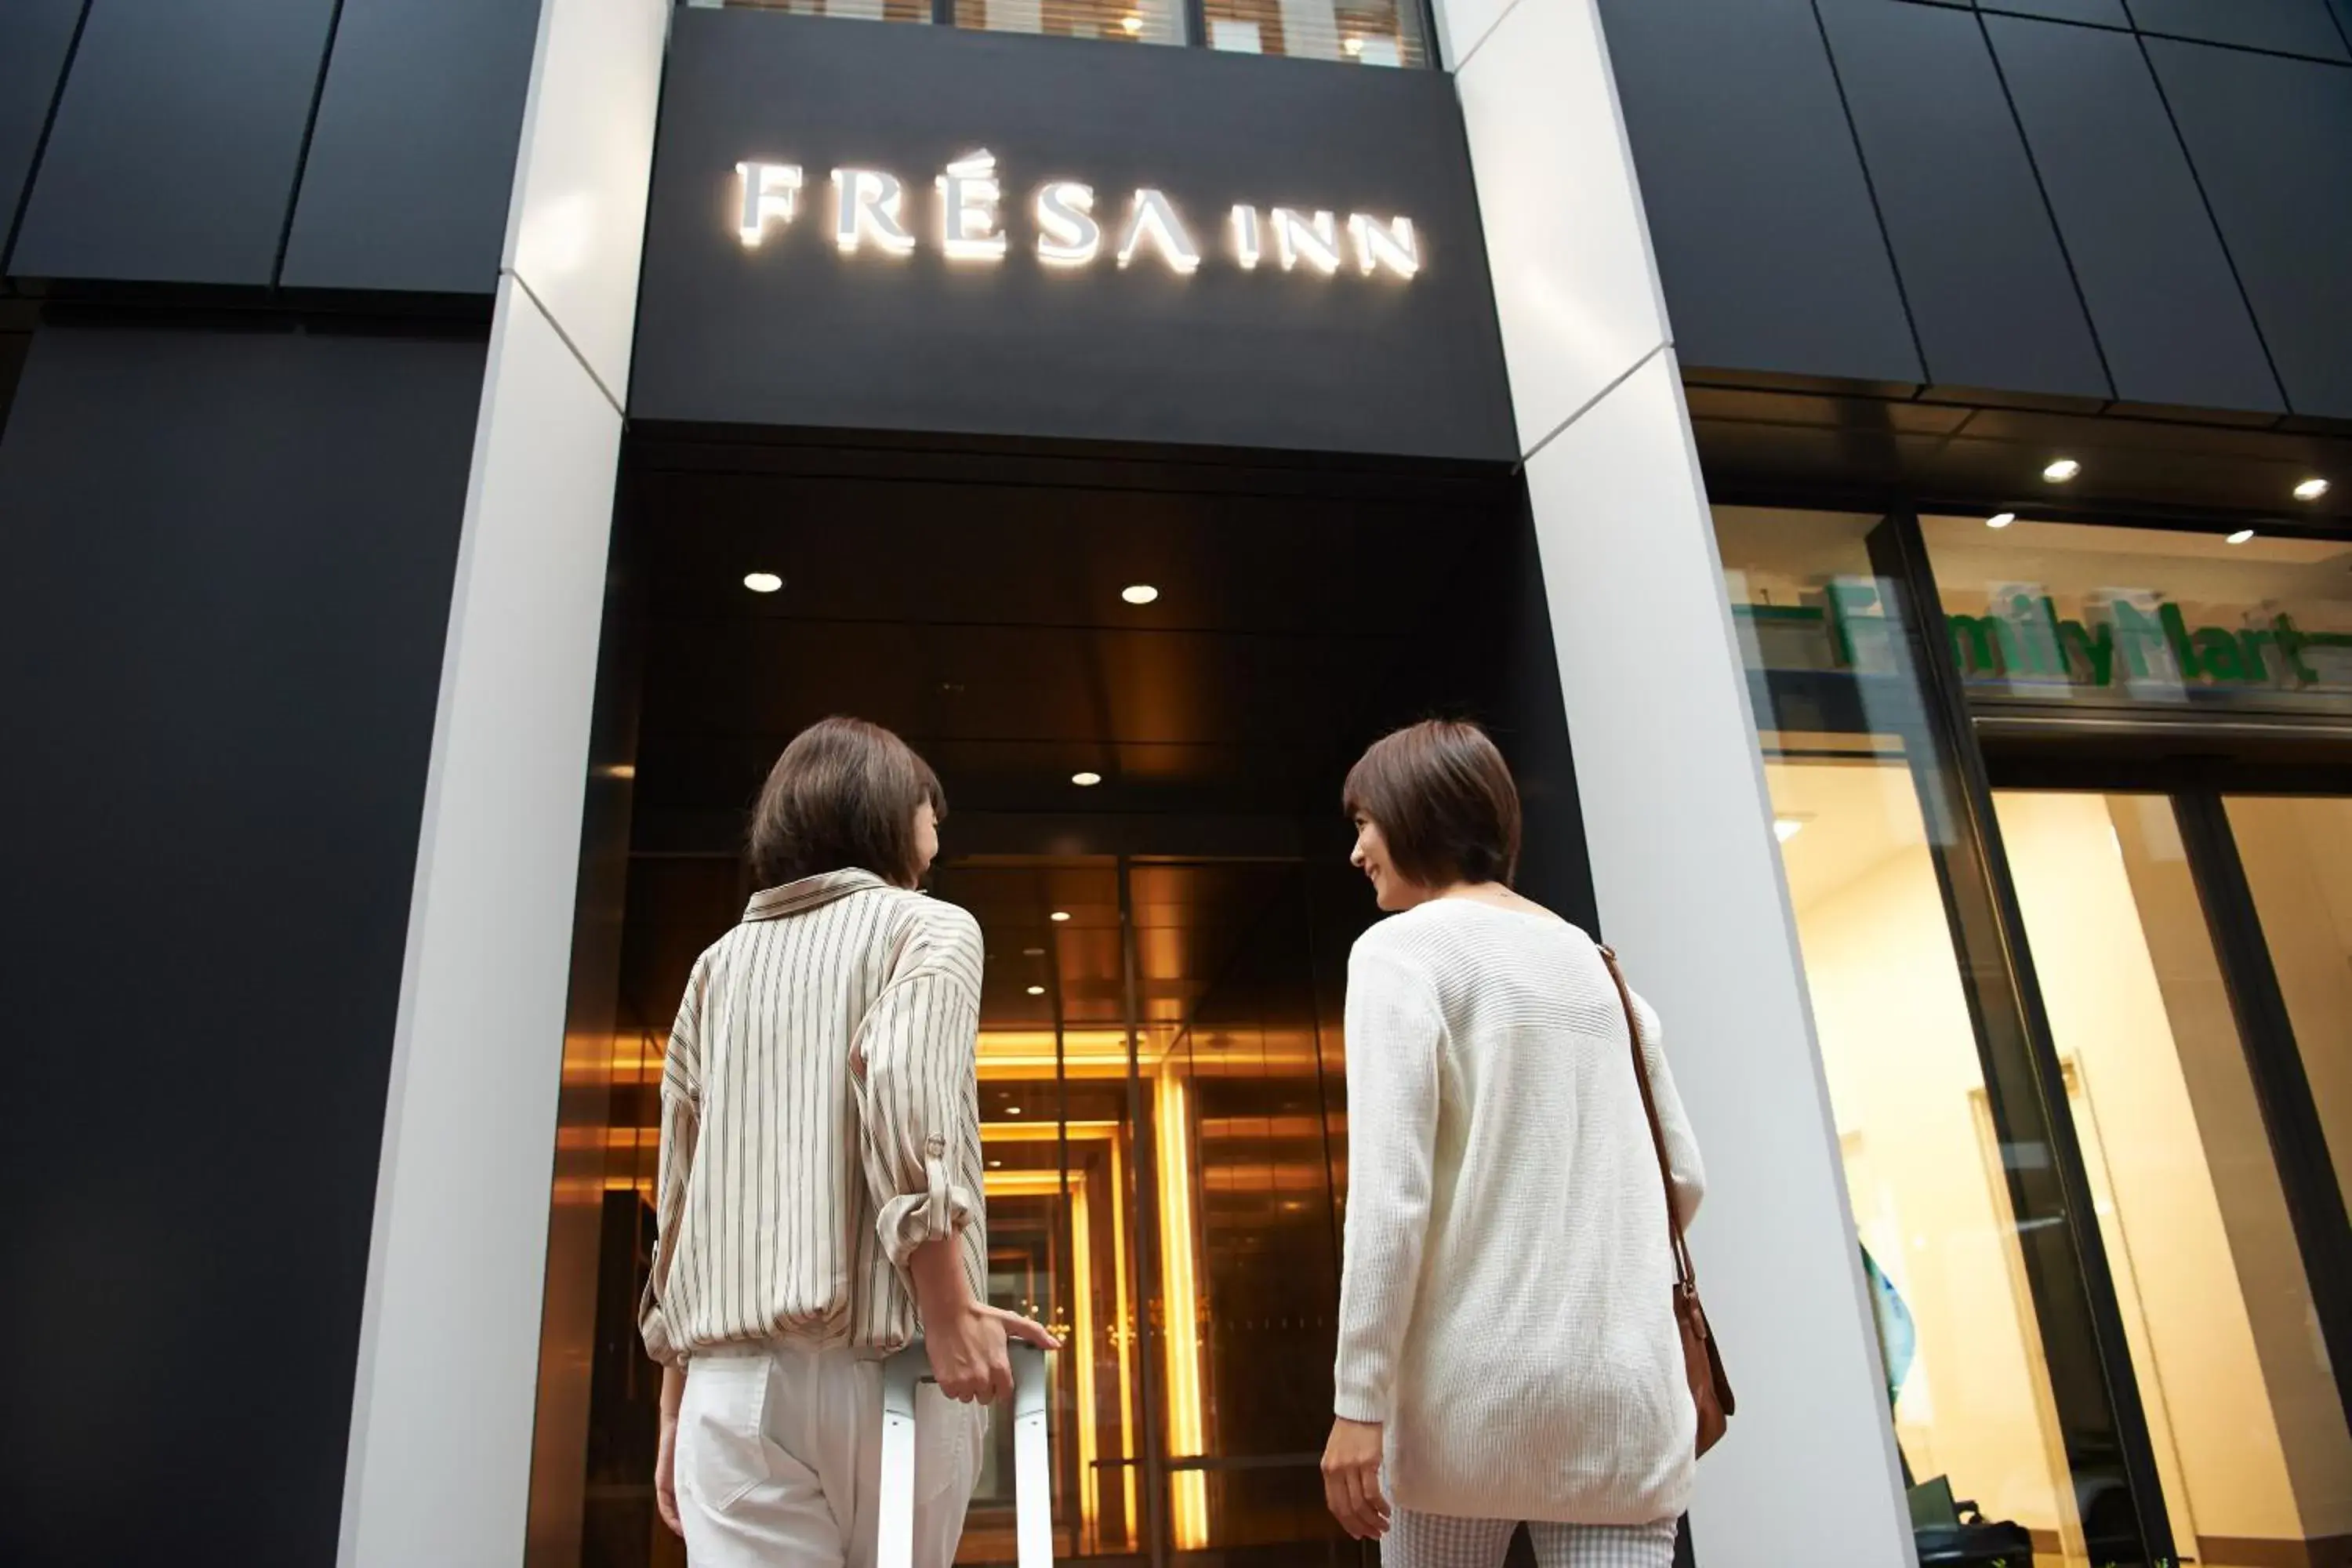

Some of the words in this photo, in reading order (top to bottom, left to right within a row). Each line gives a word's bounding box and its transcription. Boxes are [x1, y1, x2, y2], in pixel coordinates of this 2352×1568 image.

[735, 148, 1200, 273] FRÉSA
[1232, 205, 1420, 278] INN
[1824, 582, 2319, 687] FmilyMart
